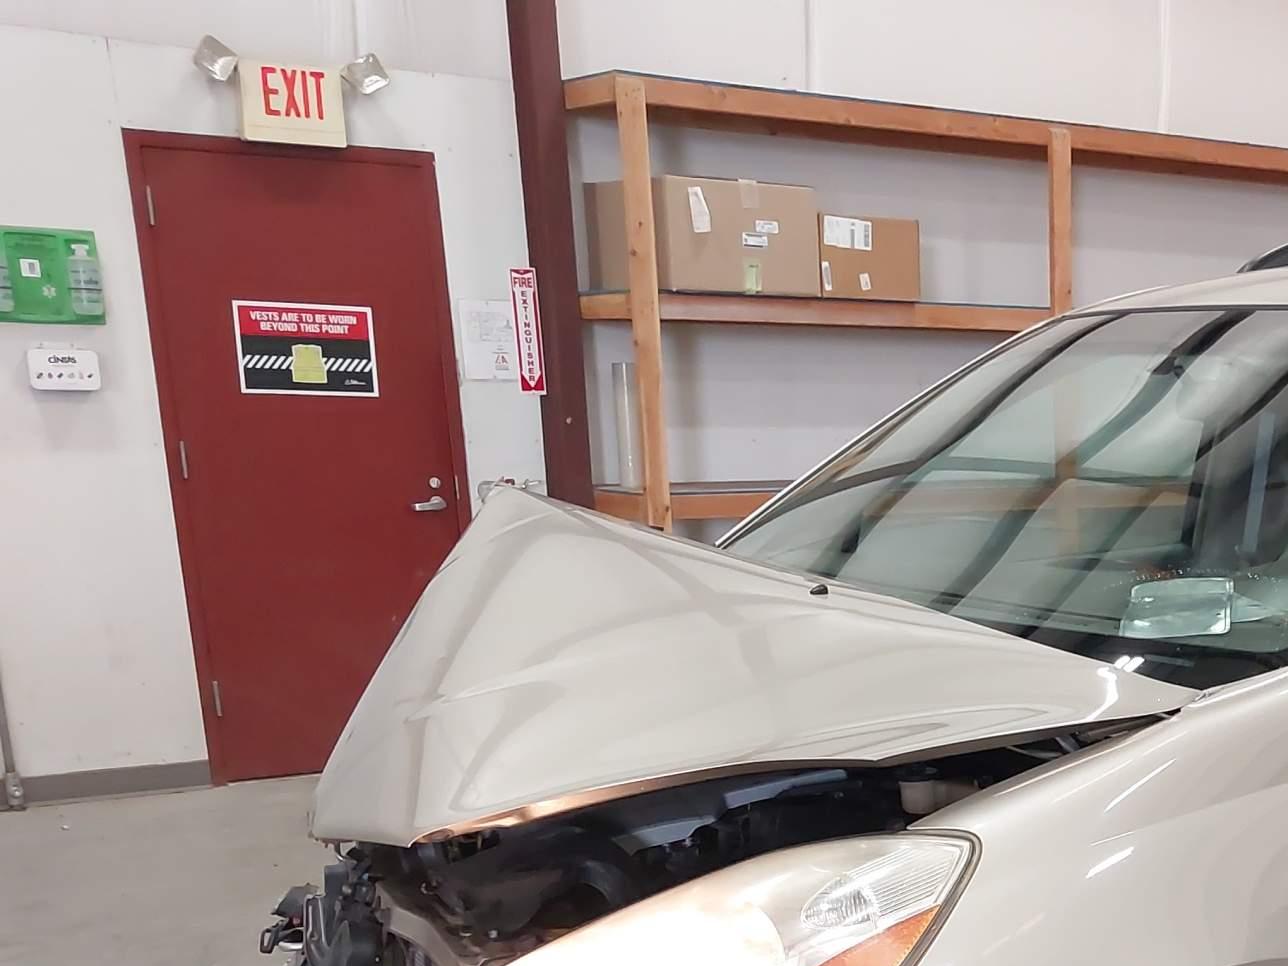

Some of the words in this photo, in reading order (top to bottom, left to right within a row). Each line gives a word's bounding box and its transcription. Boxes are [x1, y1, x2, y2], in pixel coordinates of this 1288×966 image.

[261, 66, 325, 121] EXIT
[513, 277, 533, 288] FIRE
[249, 310, 280, 322] VESTS
[281, 312, 300, 323] ARE
[301, 313, 314, 323] TO
[315, 314, 327, 324] BE
[328, 315, 358, 325] WORN
[260, 321, 298, 333] BEYOND
[300, 322, 320, 334] THIS
[322, 323, 349, 335] POINT
[520, 290, 536, 382] EXTINGUISHER
